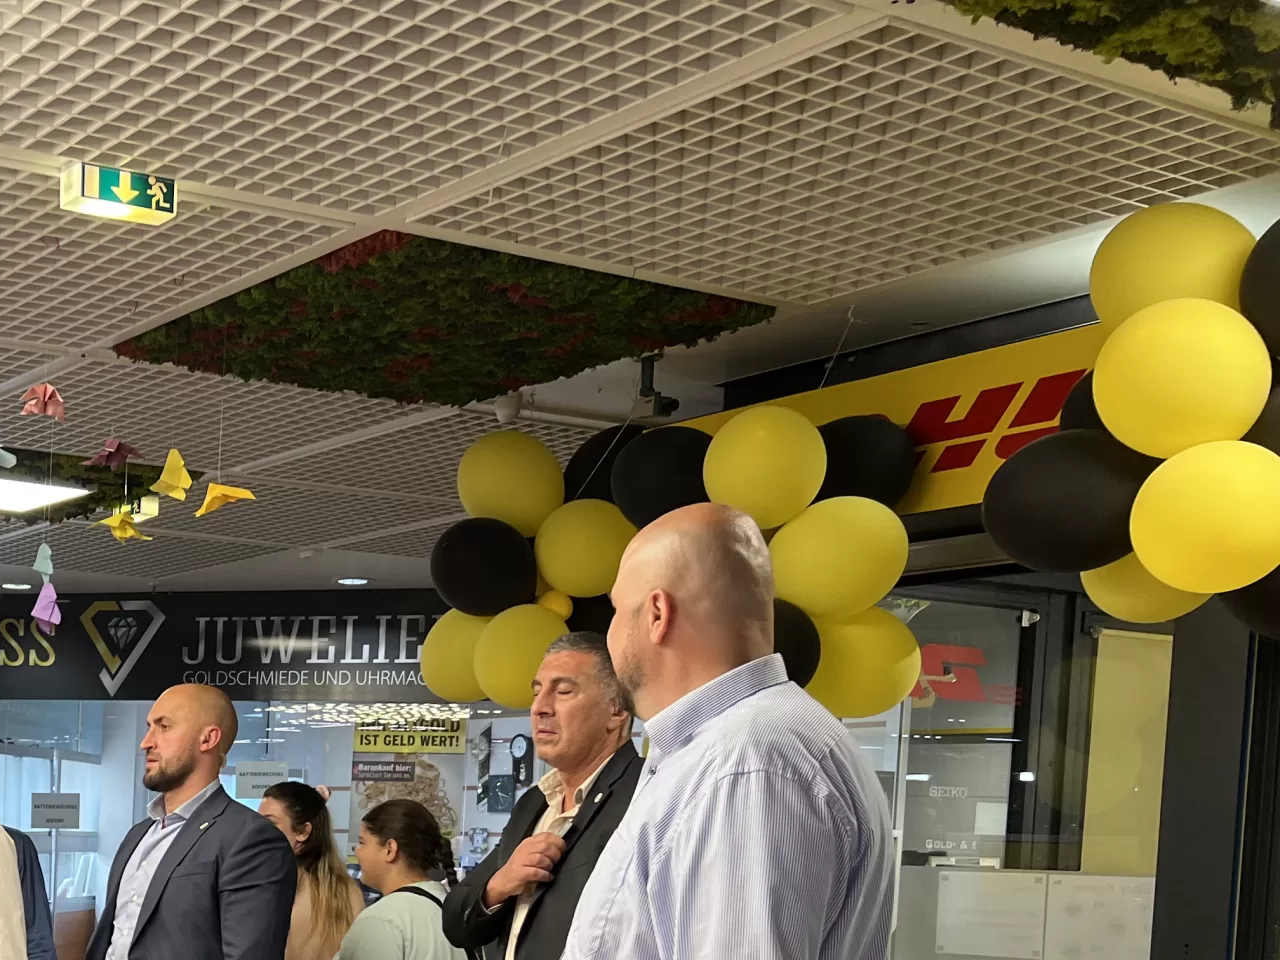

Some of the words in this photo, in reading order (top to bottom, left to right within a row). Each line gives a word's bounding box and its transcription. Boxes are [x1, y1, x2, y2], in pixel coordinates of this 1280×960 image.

[182, 614, 441, 664] JUWELIE
[183, 670, 309, 686] GOLDSCHMIEDE
[313, 670, 351, 686] UND
[359, 734, 380, 746] IST
[383, 734, 416, 747] GELD
[420, 735, 460, 748] WERT!
[929, 786, 968, 798] SEIKO
